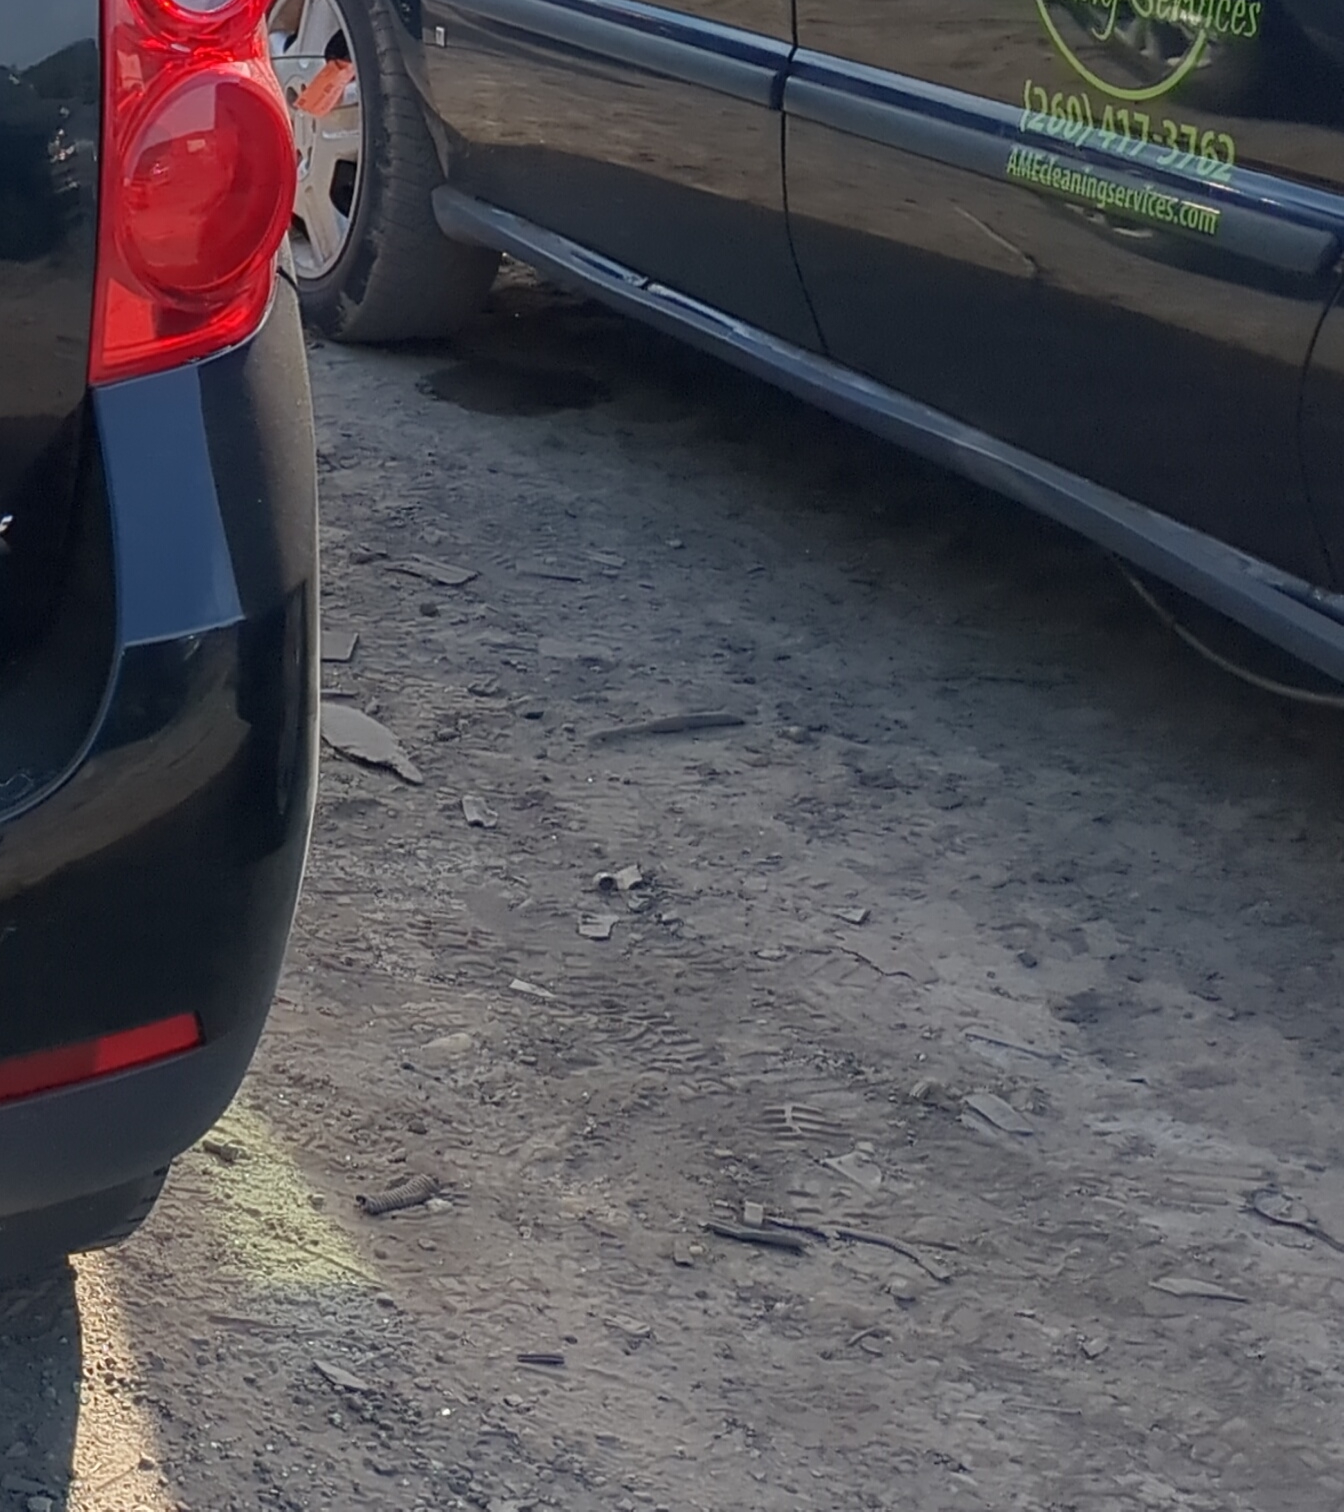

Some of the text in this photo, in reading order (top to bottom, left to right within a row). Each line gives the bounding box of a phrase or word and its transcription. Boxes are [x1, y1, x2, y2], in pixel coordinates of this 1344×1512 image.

[1019, 79, 1235, 182] (260) 417-3762
[1006, 147, 1218, 235] AMEcleaningservices.com
